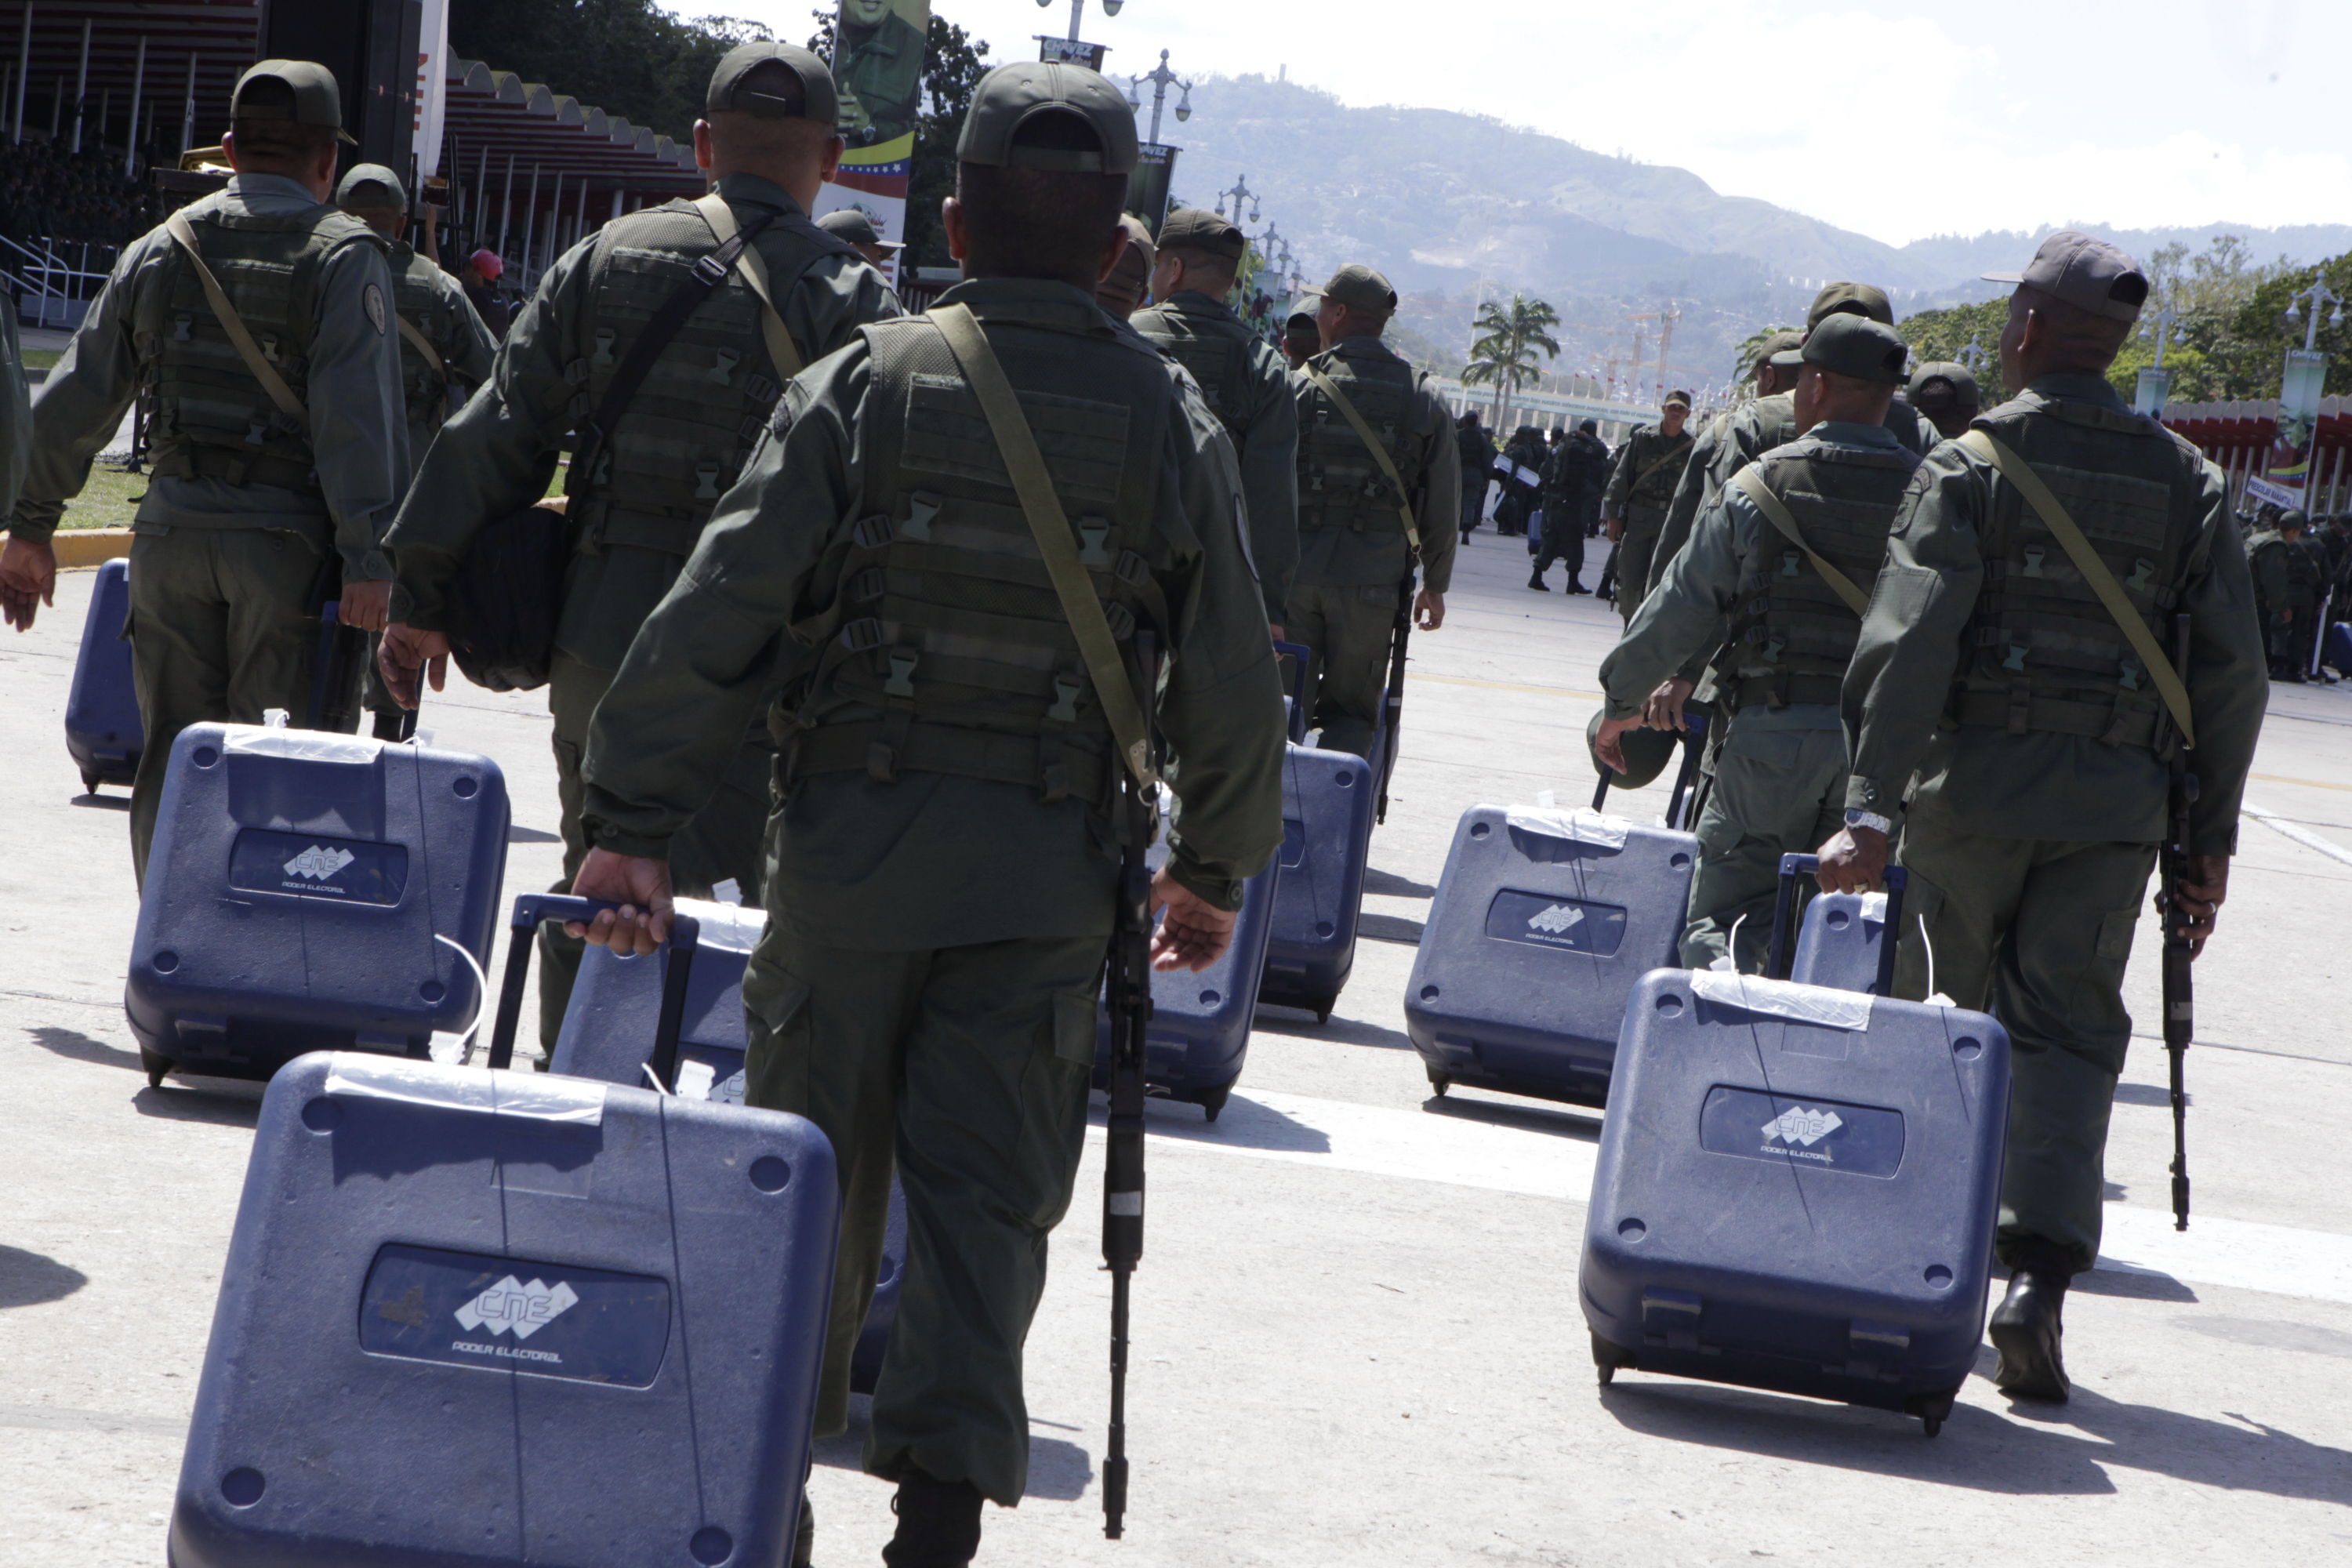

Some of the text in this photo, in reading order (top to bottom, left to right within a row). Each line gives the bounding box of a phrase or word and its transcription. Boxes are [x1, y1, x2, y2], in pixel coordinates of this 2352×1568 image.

[281, 881, 306, 890] PODER
[1760, 1145, 1835, 1162] PODER ELECTORAL
[452, 1341, 563, 1363] PODER ELECTORAL
